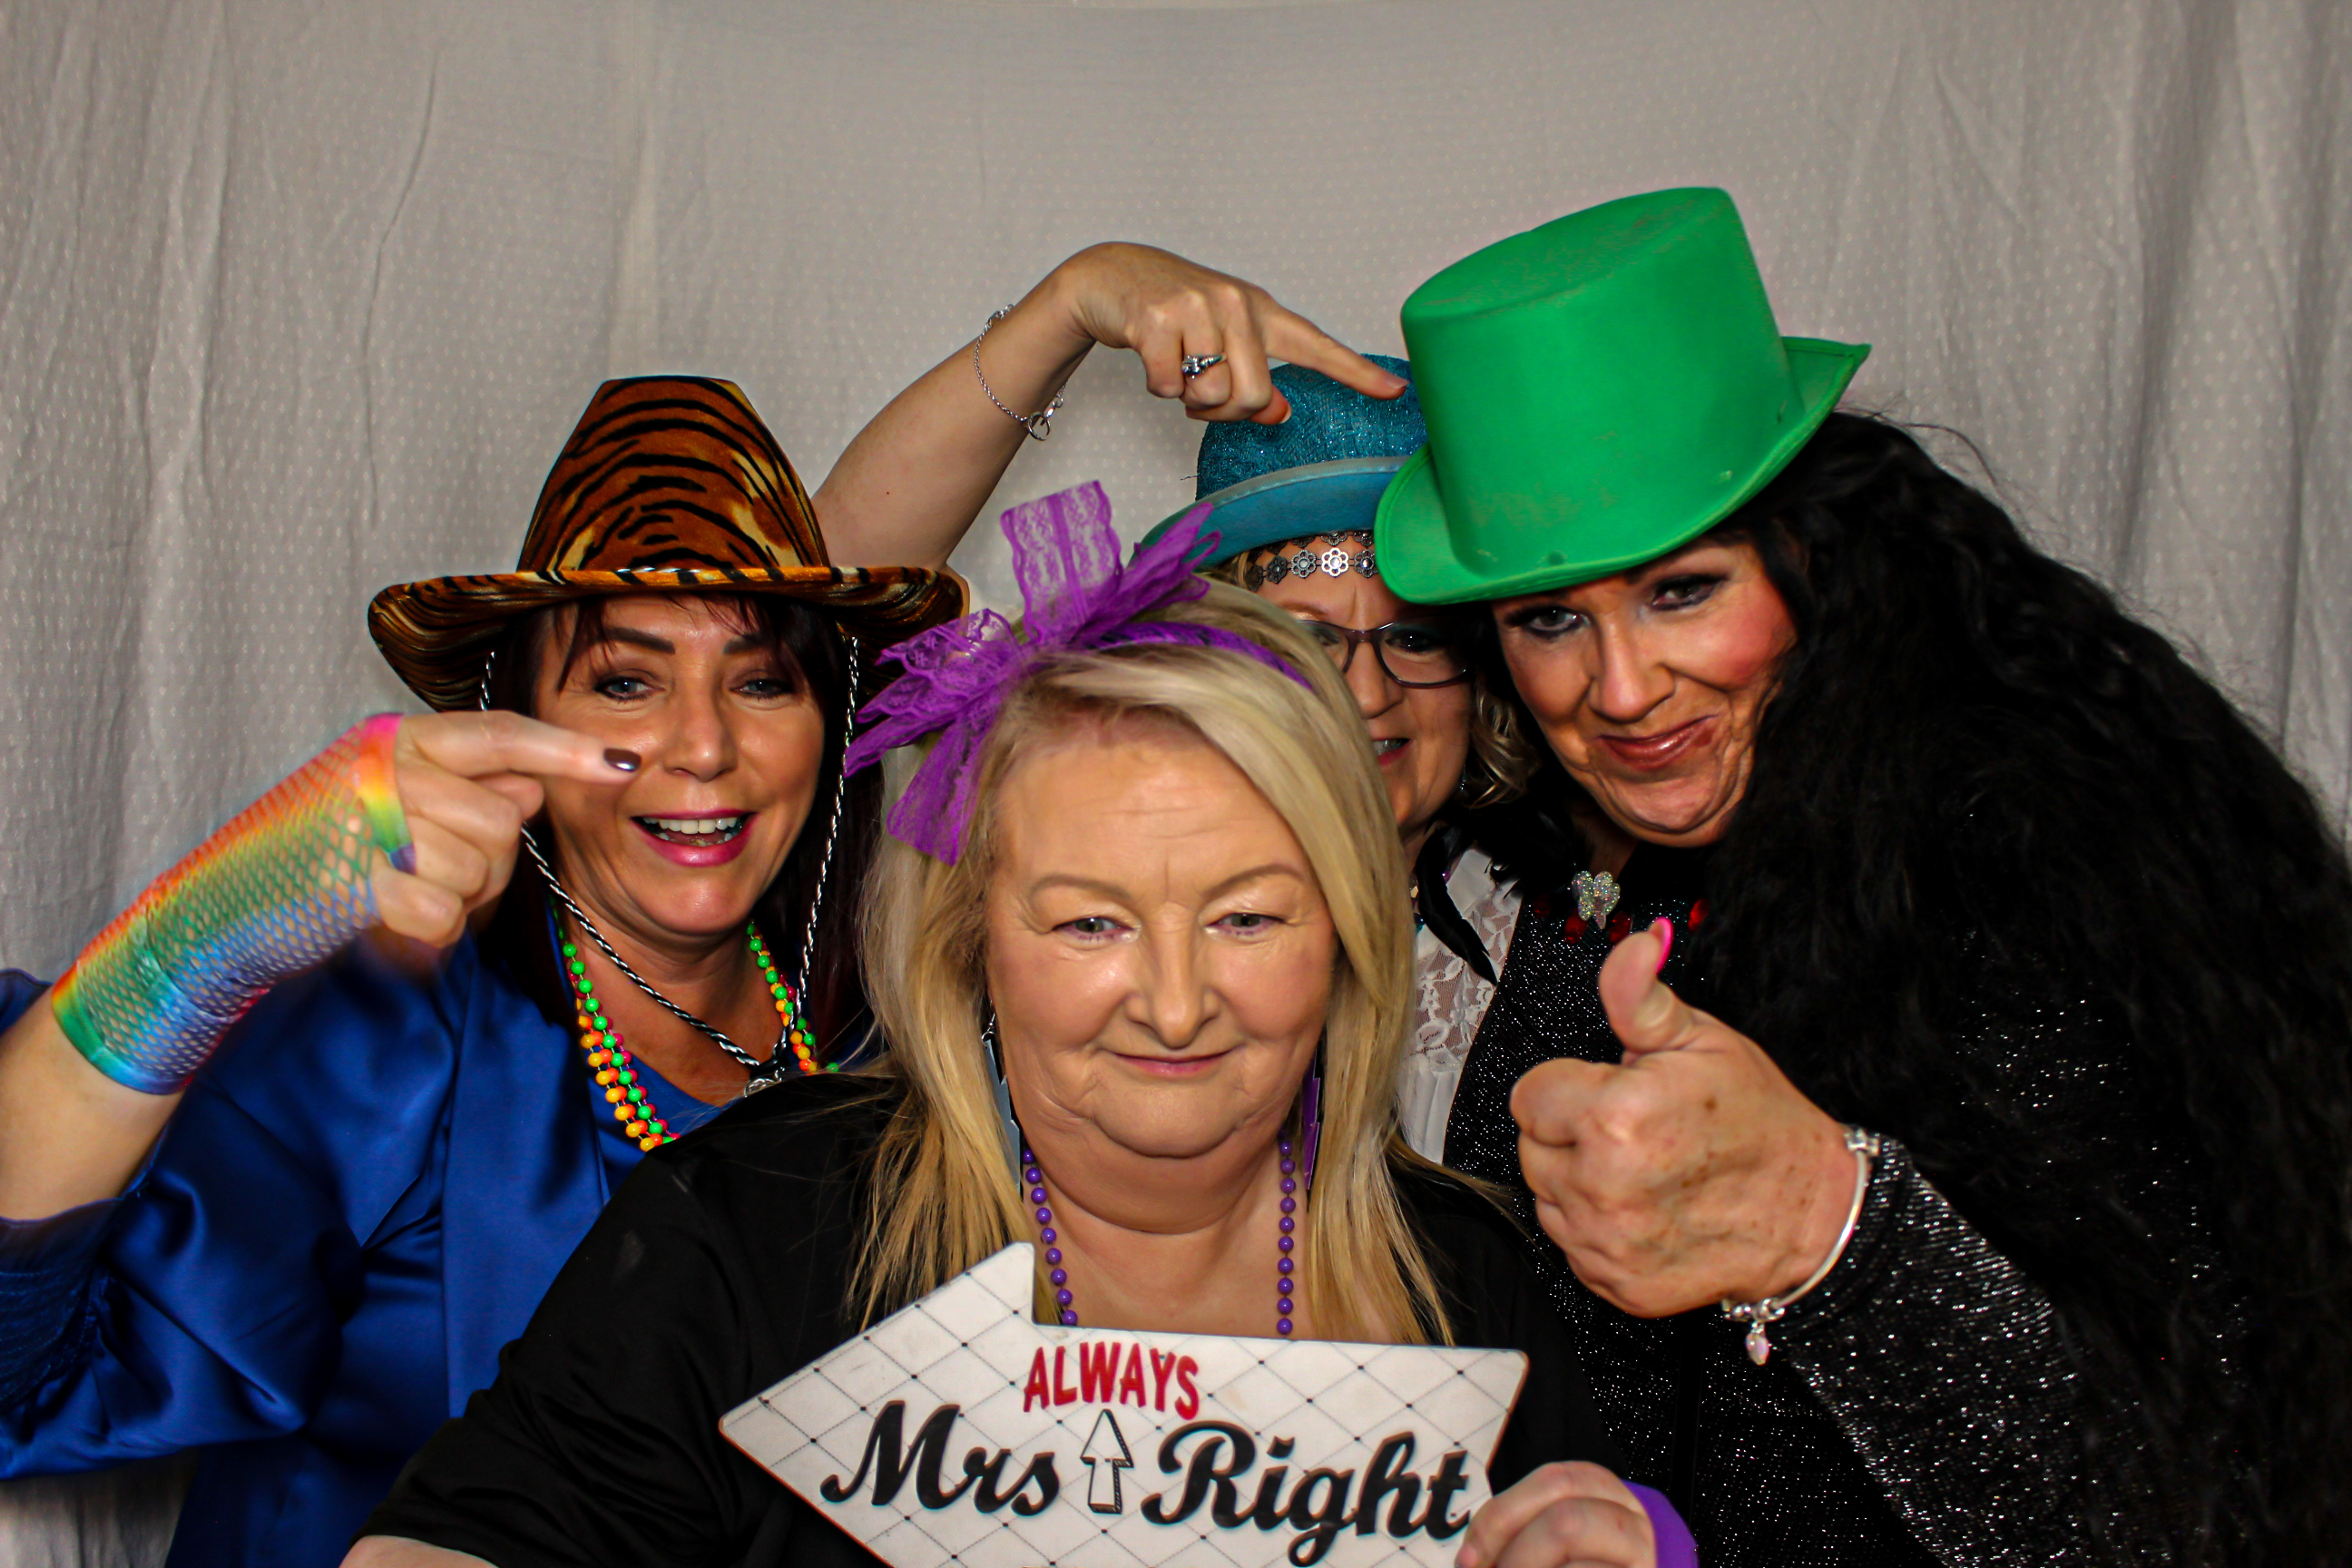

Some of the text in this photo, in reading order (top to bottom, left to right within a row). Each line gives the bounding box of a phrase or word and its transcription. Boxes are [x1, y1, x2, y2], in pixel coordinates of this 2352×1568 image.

[1024, 1342, 1200, 1420] ALWAYS
[819, 1400, 1471, 1567] Mrs Right
